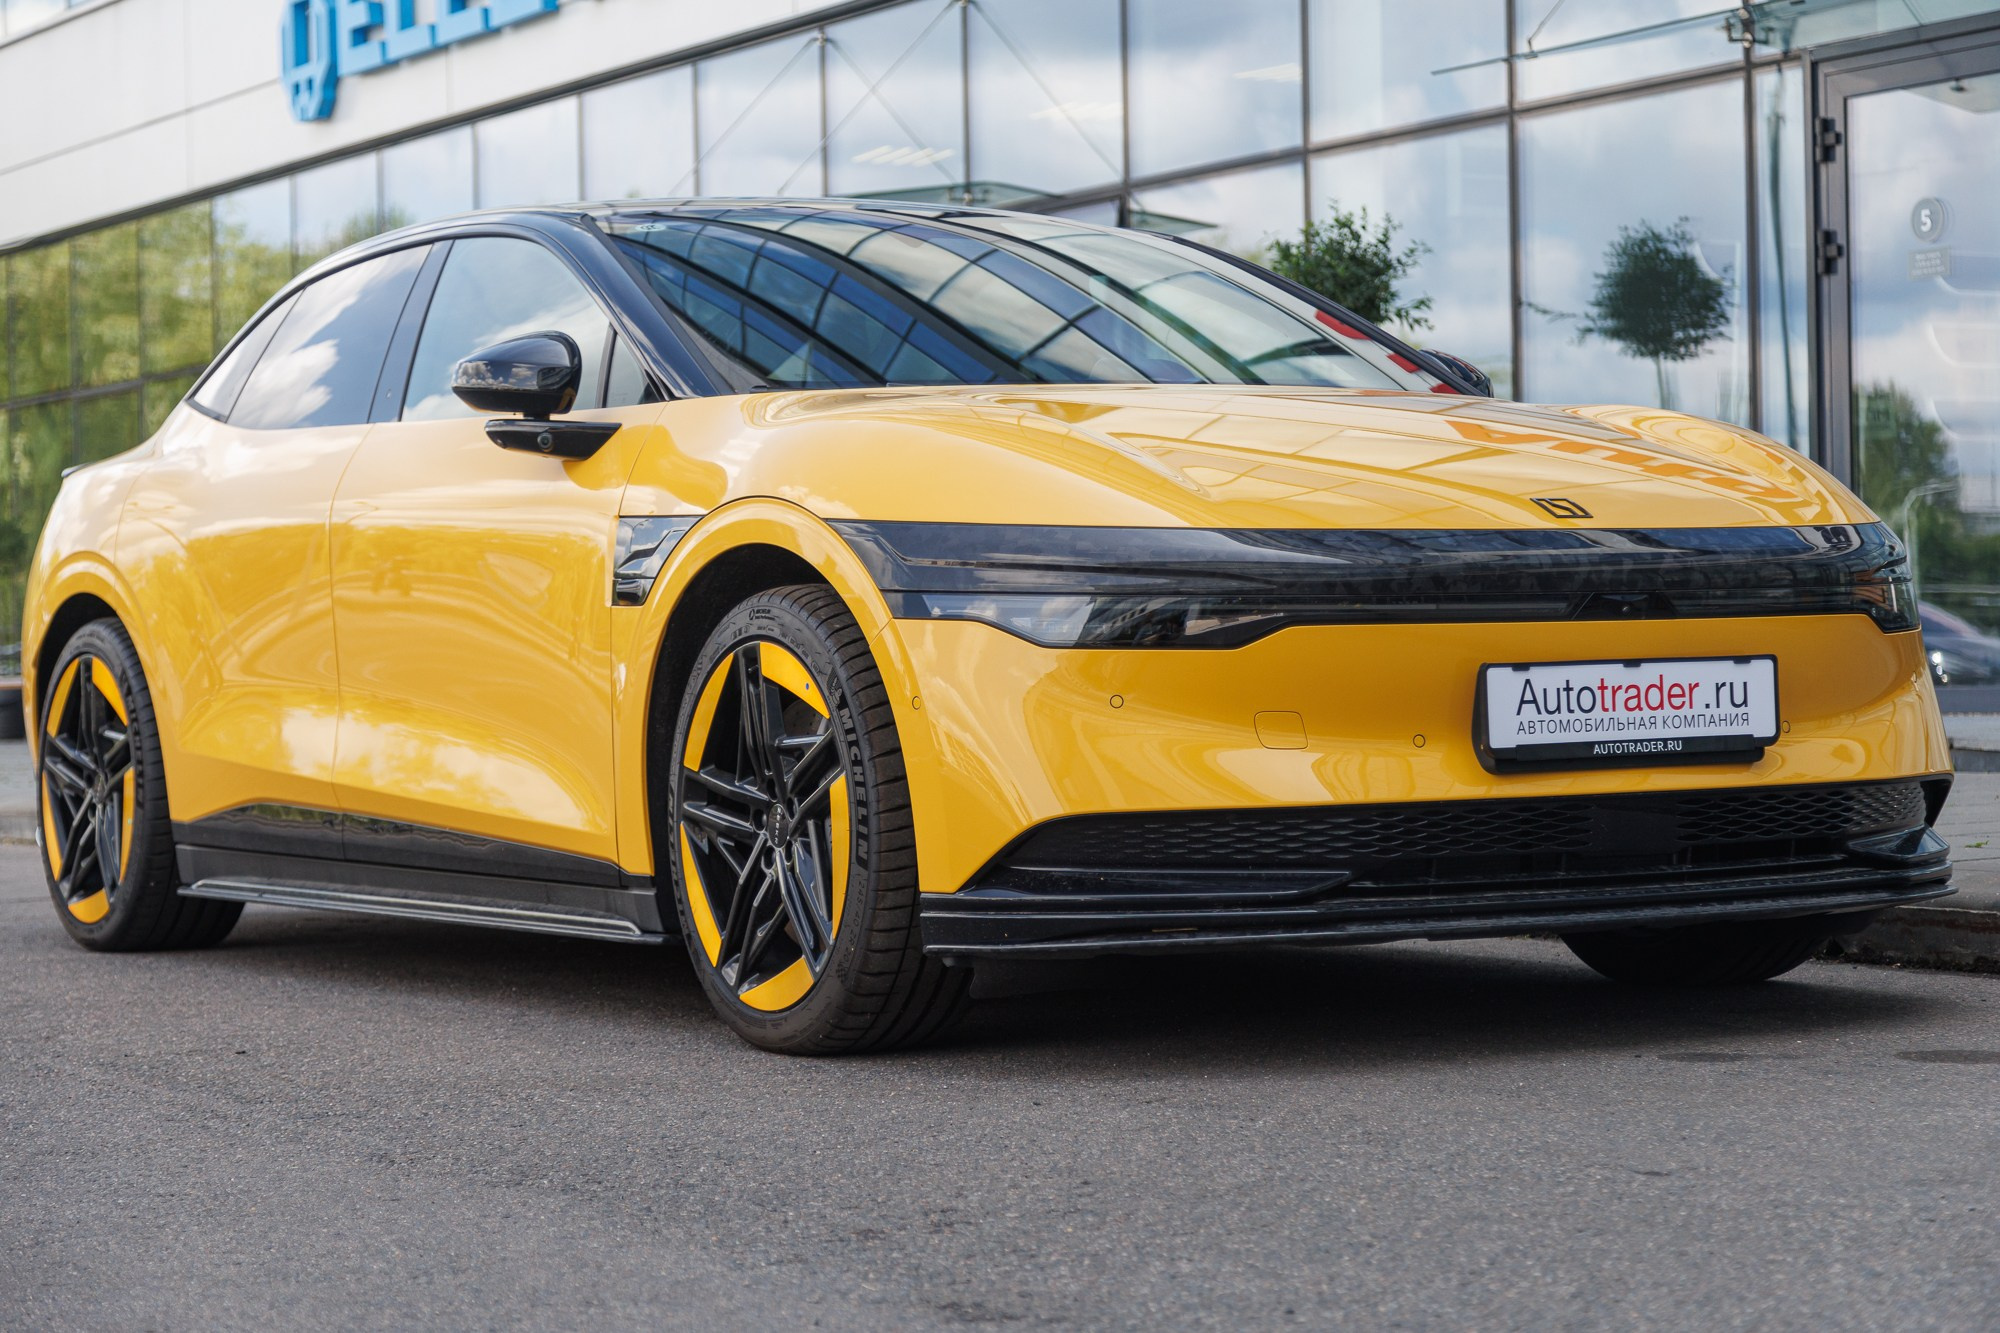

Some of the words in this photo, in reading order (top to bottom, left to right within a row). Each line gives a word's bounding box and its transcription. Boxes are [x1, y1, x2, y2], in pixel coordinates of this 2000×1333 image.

[1920, 208, 1932, 232] 5
[1516, 674, 1748, 715] Autotrader.ru
[1516, 715, 1657, 735] АВТОМОБИЛЬНАЯ
[1663, 712, 1750, 730] КОМПАНИЯ
[1593, 741, 1682, 755] AUTOTRADER.RU
[840, 707, 868, 860] MICHELIN
